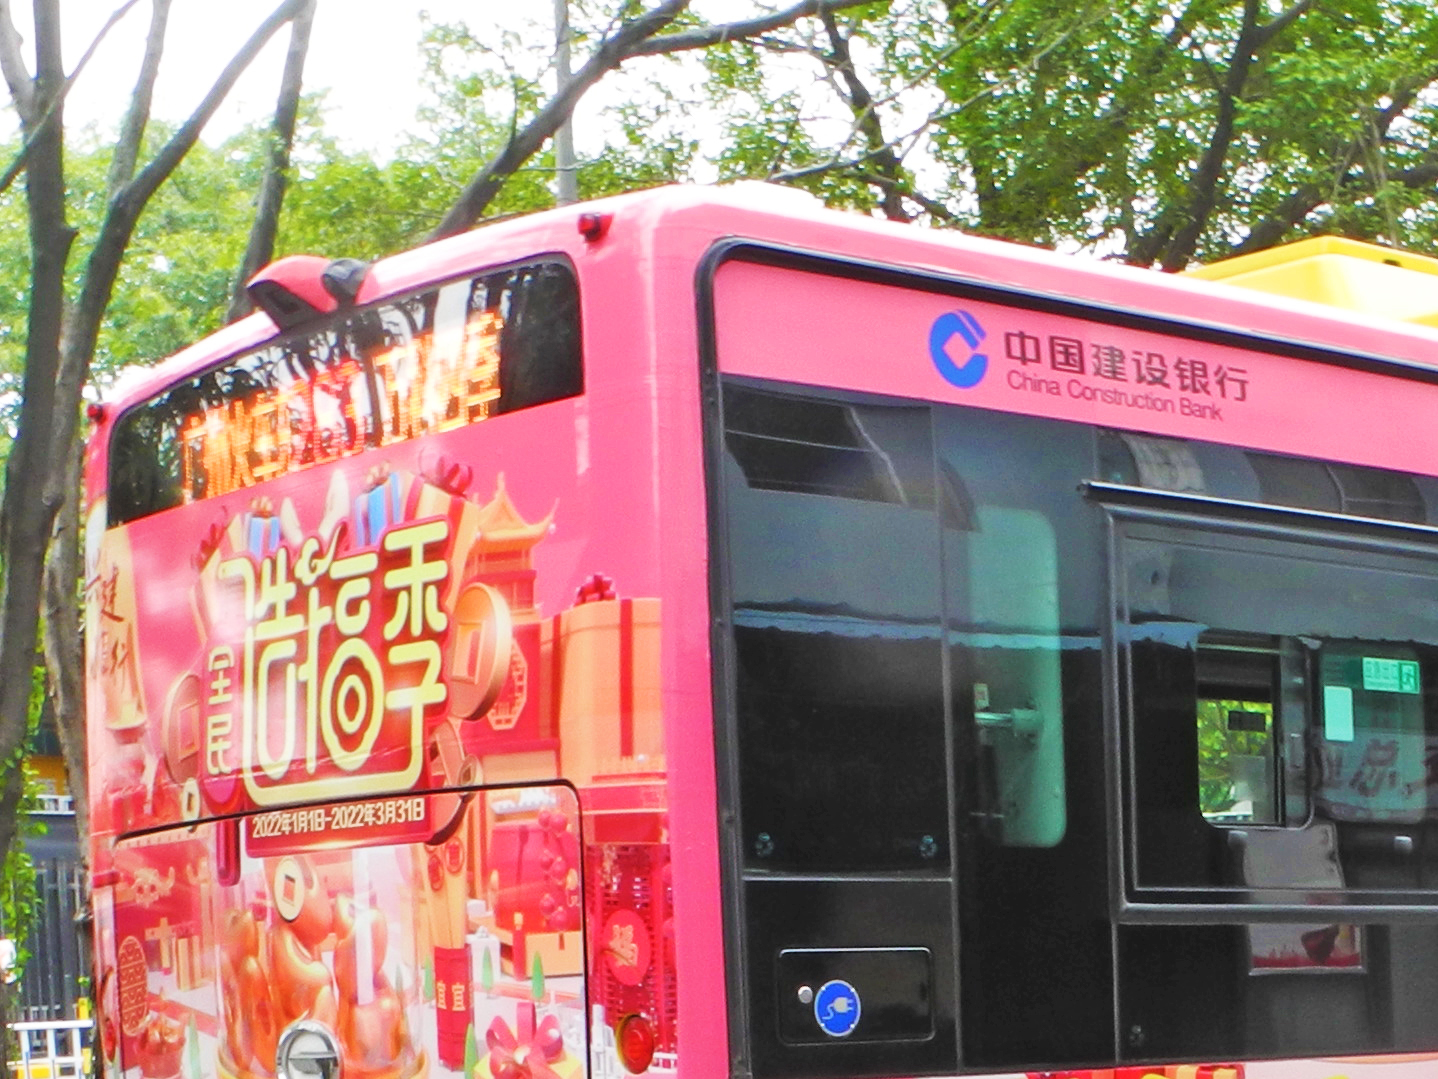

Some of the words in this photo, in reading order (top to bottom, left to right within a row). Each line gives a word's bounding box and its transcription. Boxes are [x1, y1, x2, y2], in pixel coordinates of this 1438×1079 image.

[1004, 330, 1249, 401] 中国建设银行
[1007, 371, 1061, 397] China
[1067, 378, 1175, 415] Construction
[1180, 398, 1224, 422] Bank
[252, 797, 425, 839] 2022年1月1日-2022年3月31日
